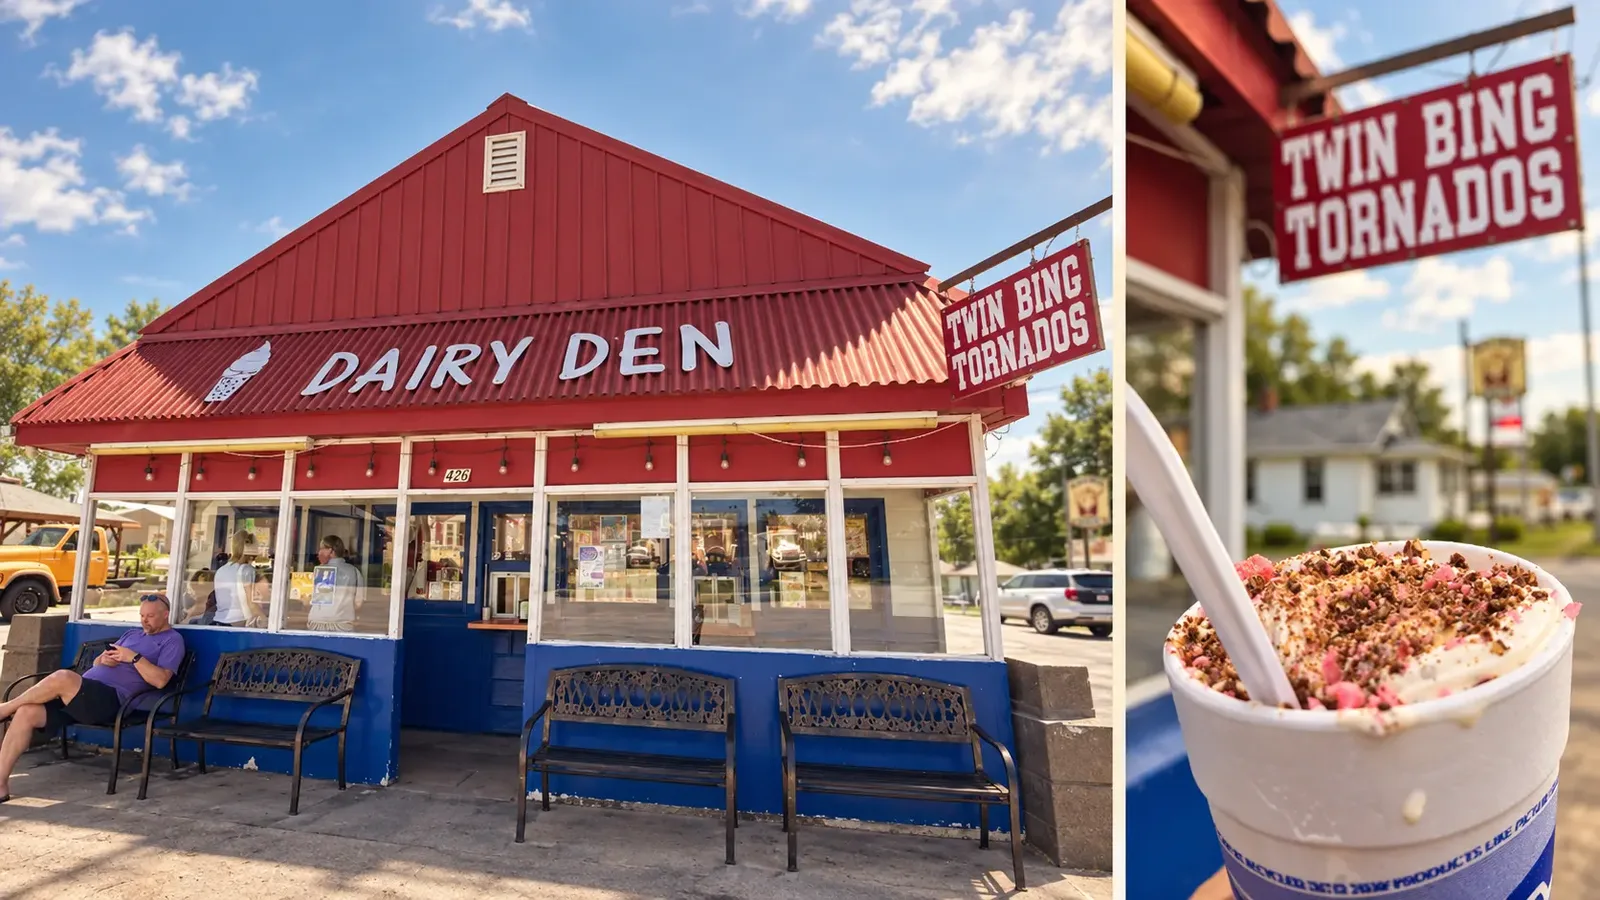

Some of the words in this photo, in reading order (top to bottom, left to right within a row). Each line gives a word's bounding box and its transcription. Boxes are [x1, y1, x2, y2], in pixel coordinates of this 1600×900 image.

[1281, 112, 1397, 199] TWIN
[1421, 73, 1558, 169] BING
[1285, 147, 1565, 271] TORNADOS
[946, 289, 1006, 350] TWIN
[1014, 254, 1082, 321] BING
[951, 301, 1090, 391] TORNADOS
[300, 336, 535, 396] DAIRY
[559, 321, 734, 380] DEN
[446, 469, 470, 481] 426
